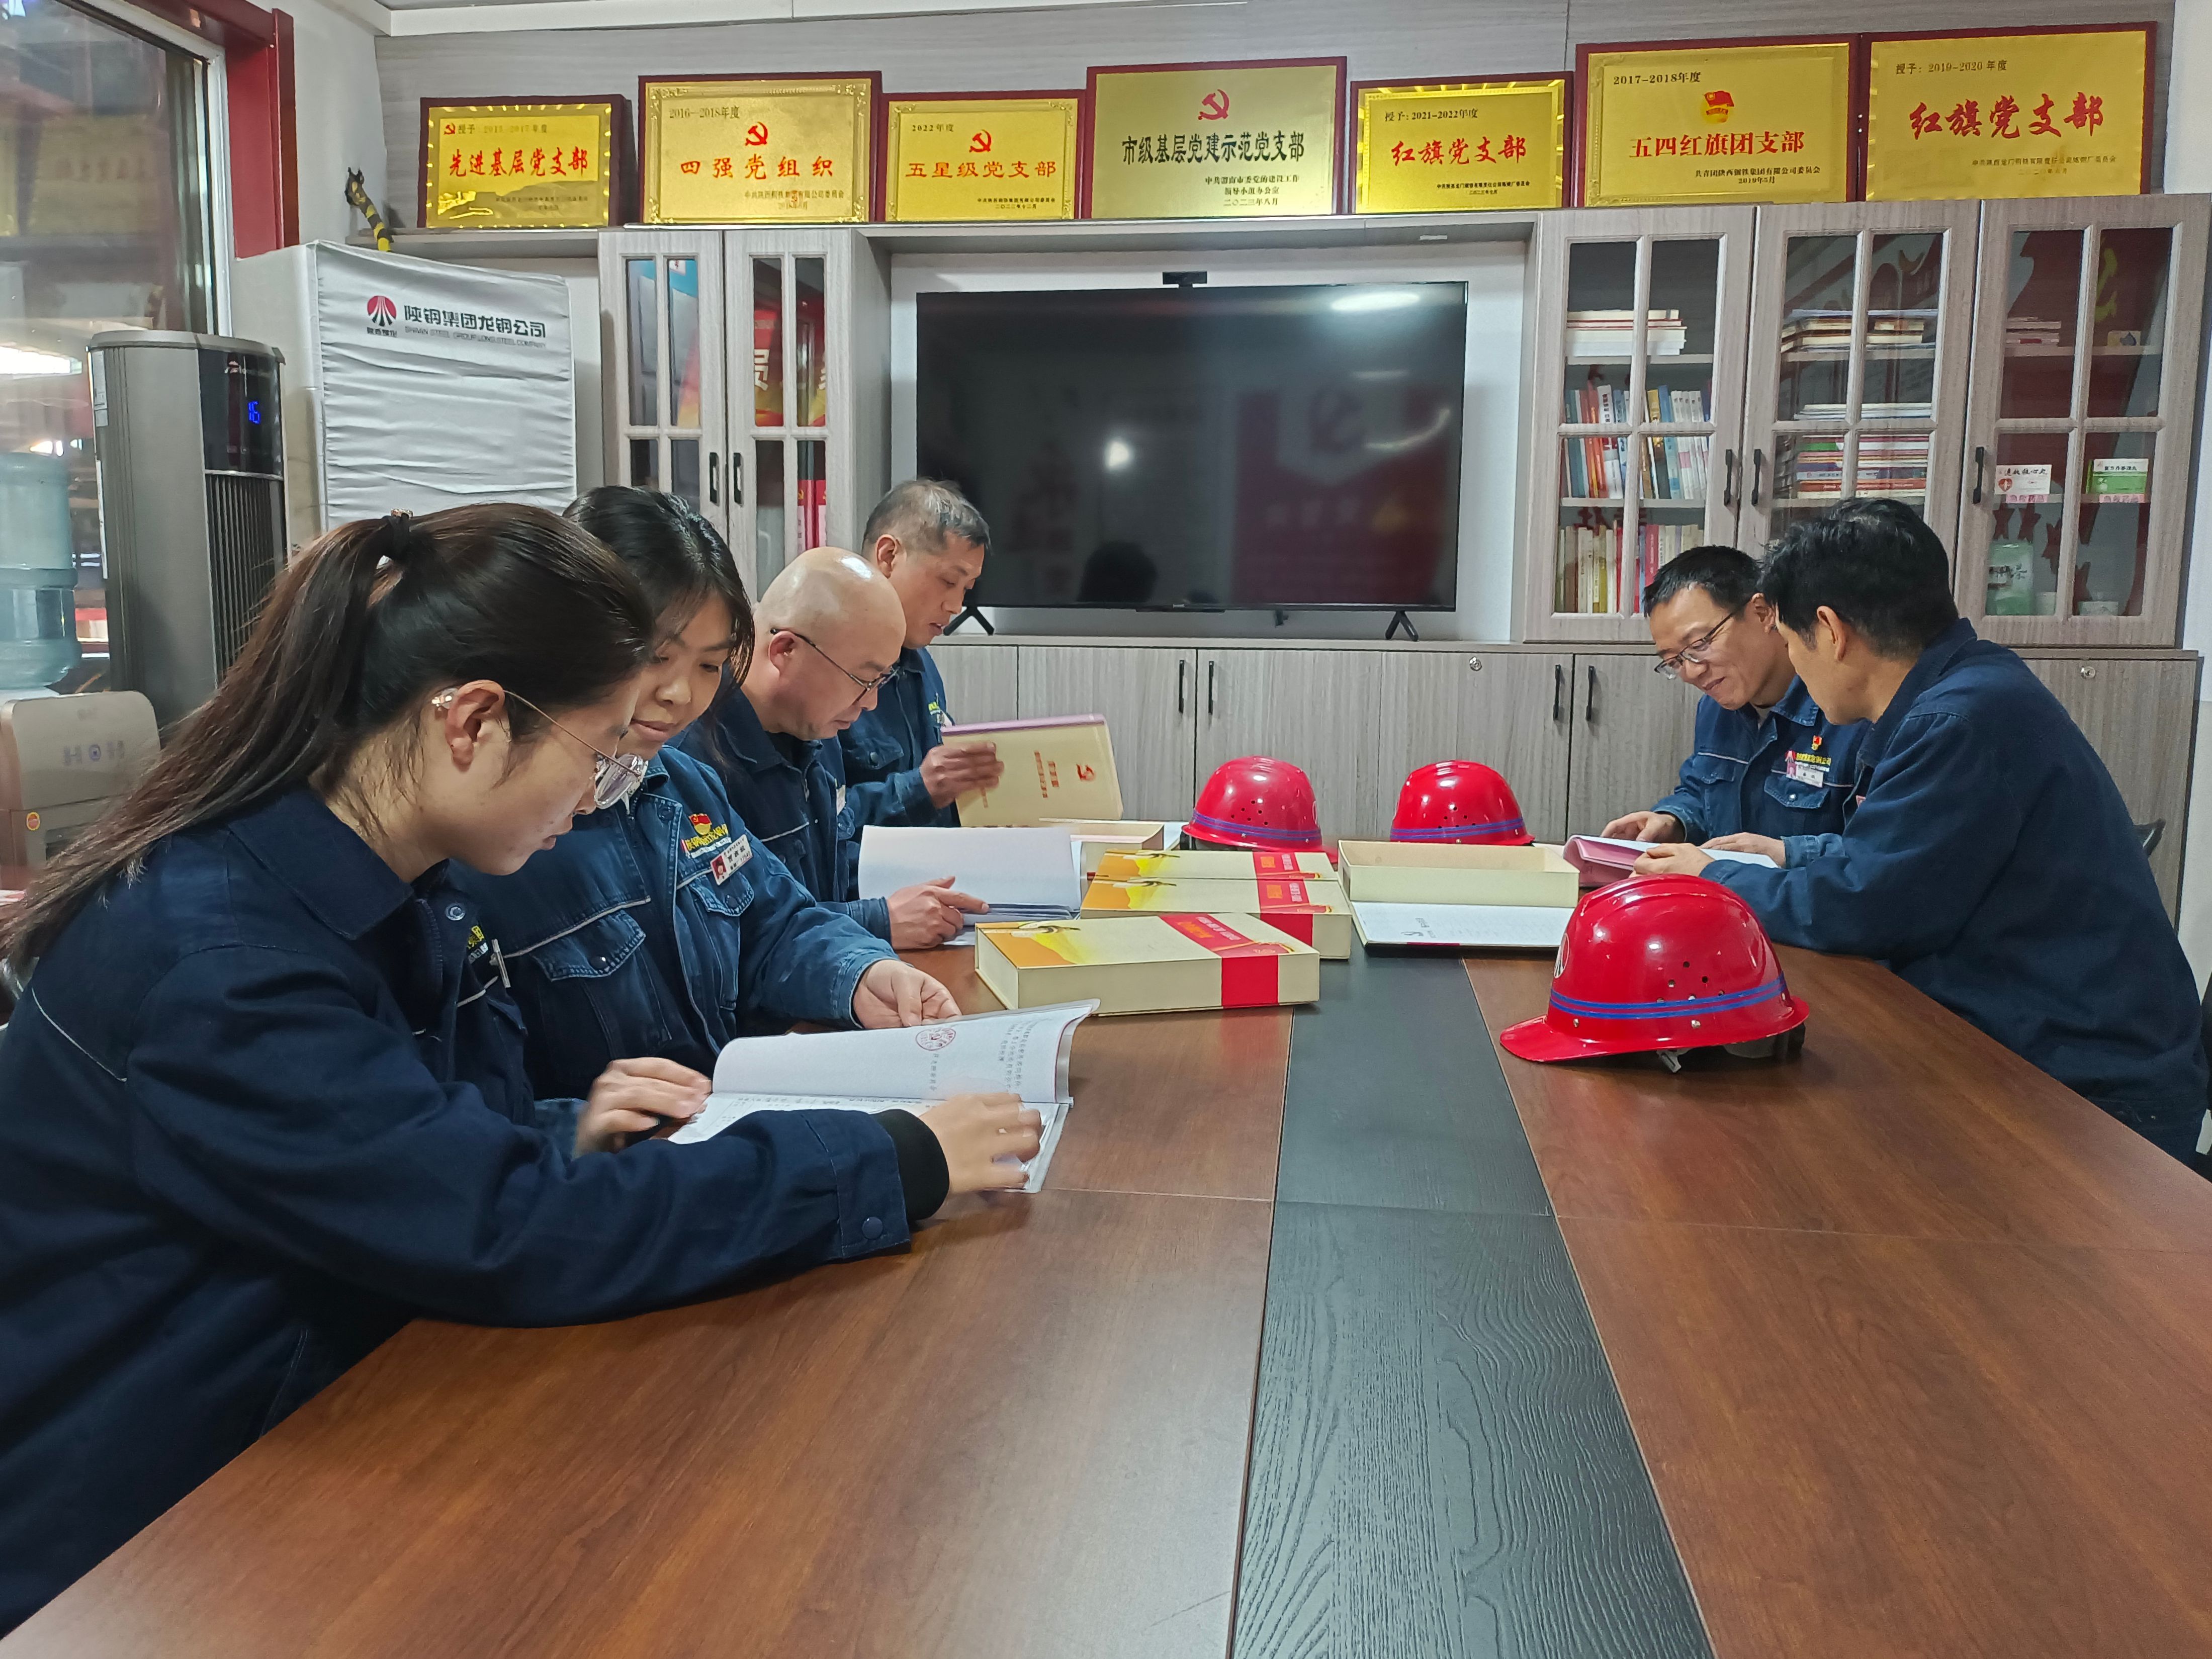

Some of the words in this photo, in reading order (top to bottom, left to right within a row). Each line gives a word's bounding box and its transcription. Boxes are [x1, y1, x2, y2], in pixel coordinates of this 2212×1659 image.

[1613, 71, 1701, 85] 2017-2018年度
[1909, 92, 2103, 140] 红旗党支部
[1122, 130, 1305, 165] 市级基层党建示范党支部
[1391, 135, 1527, 166] 红旗党支部
[1629, 130, 1805, 158] 五四红旗团支部
[450, 146, 588, 177] 先进基层党支部
[680, 153, 834, 180] 四强党组织
[905, 161, 1056, 179] 五星级党支部
[404, 305, 546, 338] 陕钢集团龙钢公司
